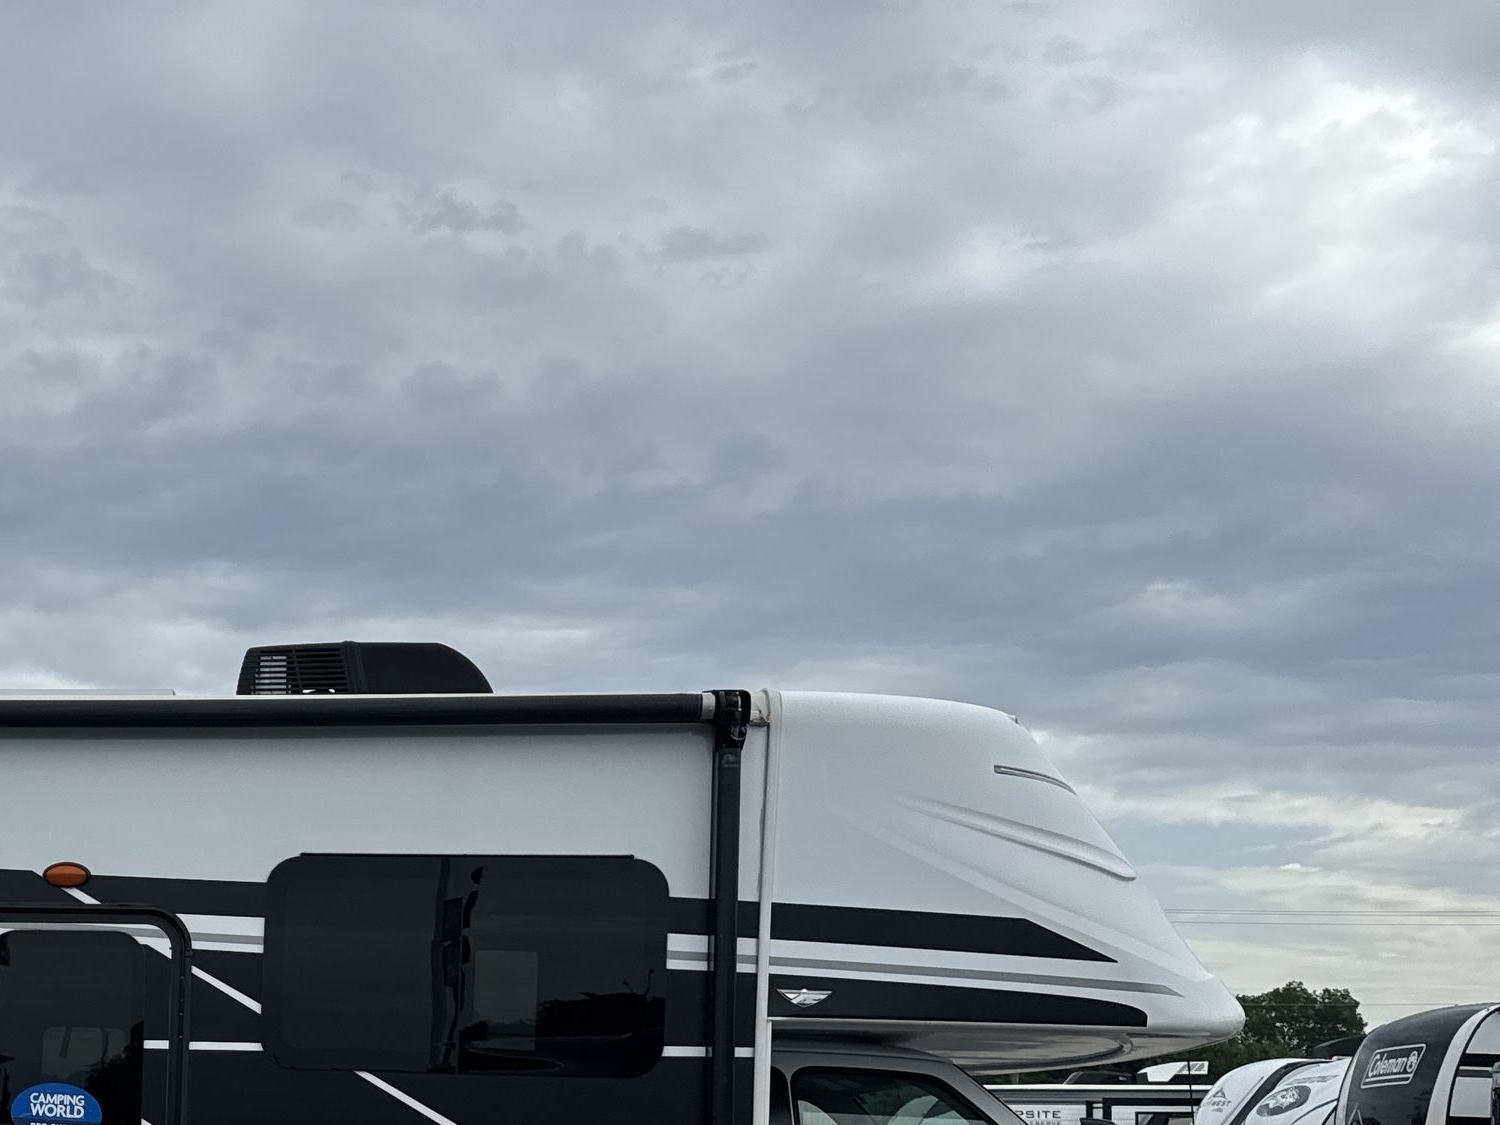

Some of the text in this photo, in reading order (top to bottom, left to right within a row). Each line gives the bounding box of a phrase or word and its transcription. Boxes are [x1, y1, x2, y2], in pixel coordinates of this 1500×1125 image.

[1368, 1053, 1408, 1077] Coleman
[29, 1092, 85, 1107] CAMPING
[30, 1103, 85, 1119] WORLD
